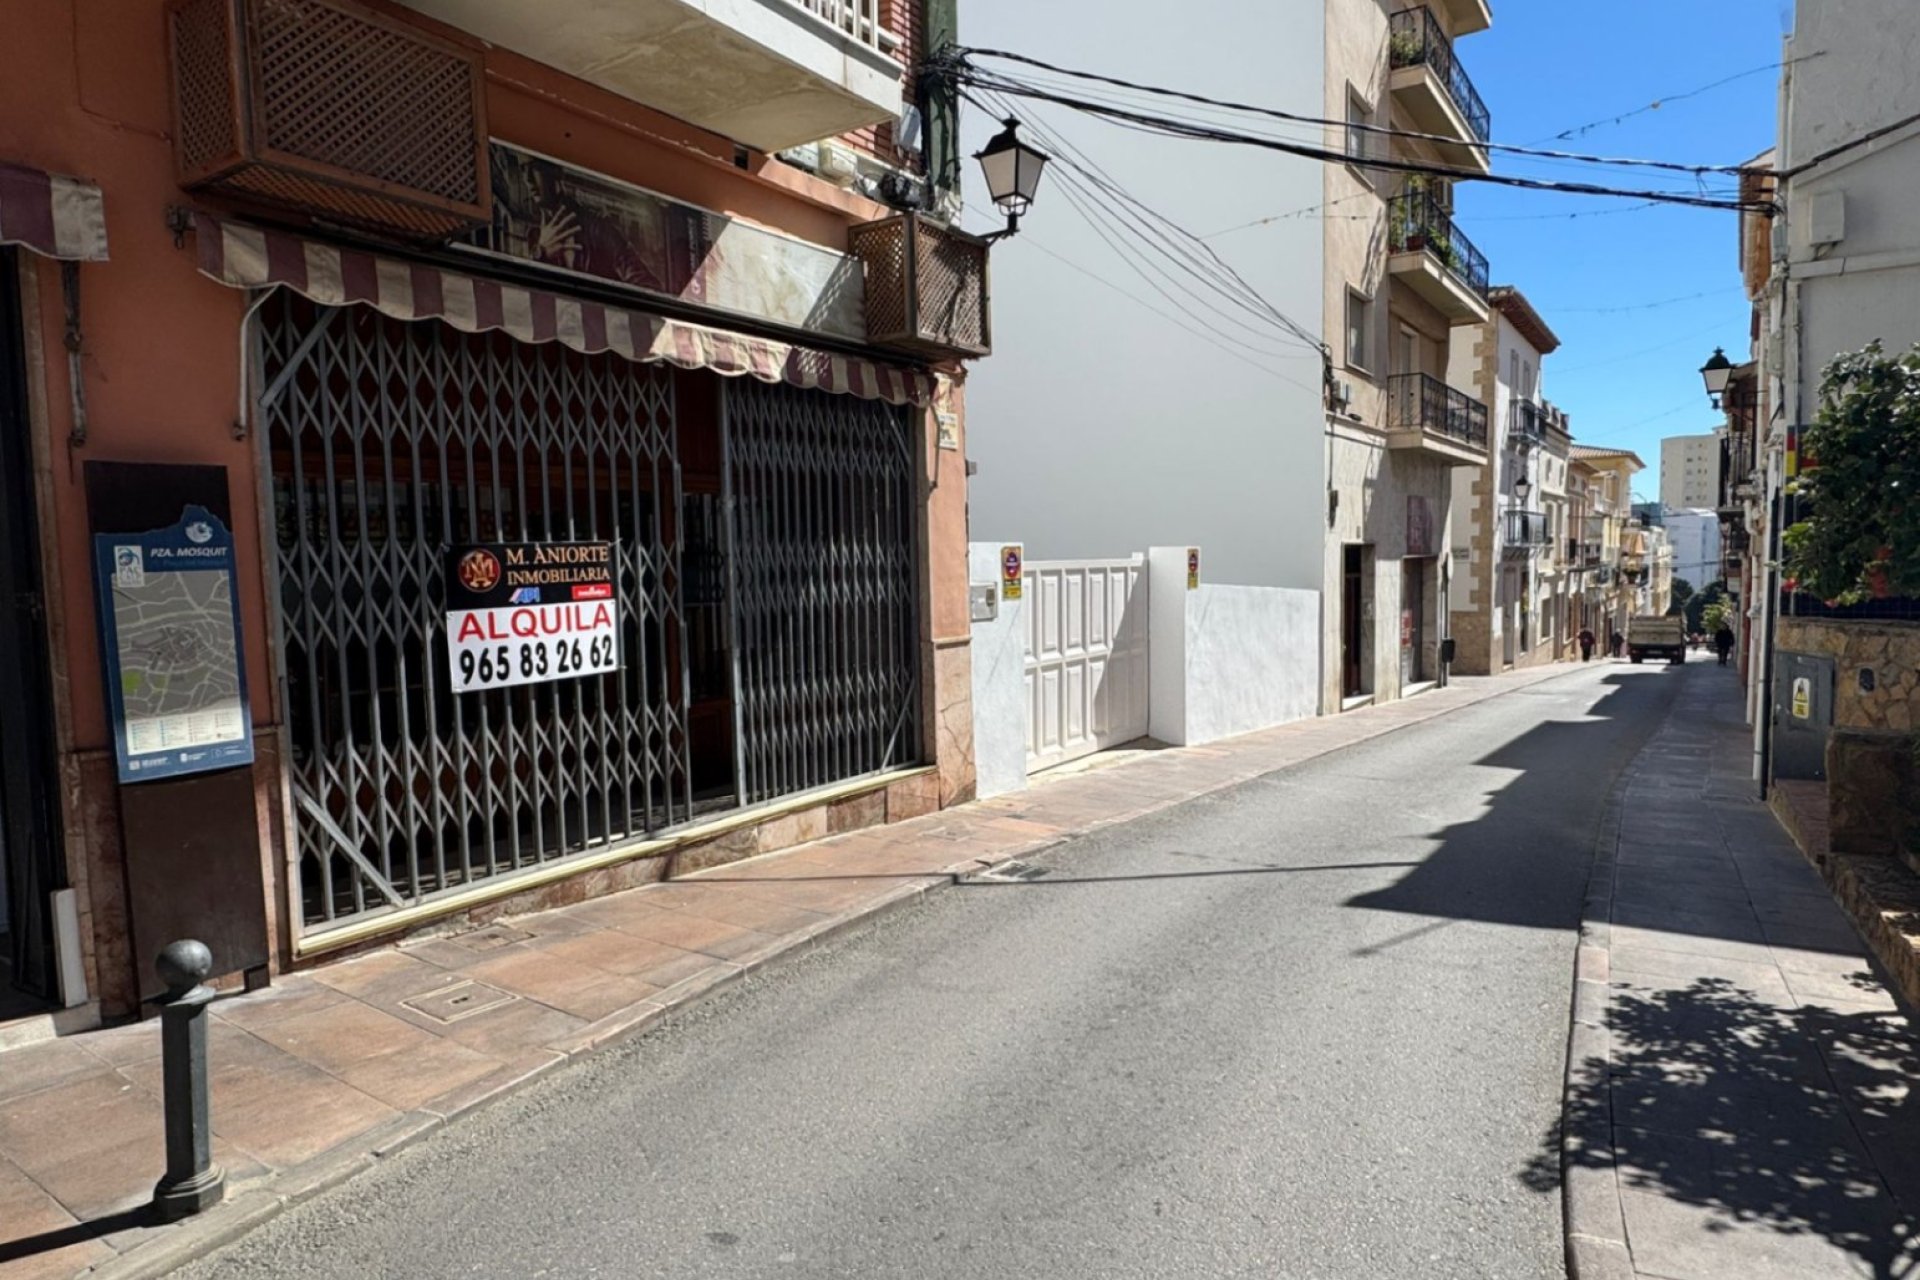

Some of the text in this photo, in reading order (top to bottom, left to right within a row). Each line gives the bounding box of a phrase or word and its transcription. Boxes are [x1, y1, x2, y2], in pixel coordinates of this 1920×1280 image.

[150, 546, 227, 557] PZA. MOSQUIT
[506, 548, 530, 565] M.
[507, 567, 610, 585] INMOBILIARIA
[458, 603, 611, 642] ALQUILA
[460, 635, 613, 685] 965 83 26 62
